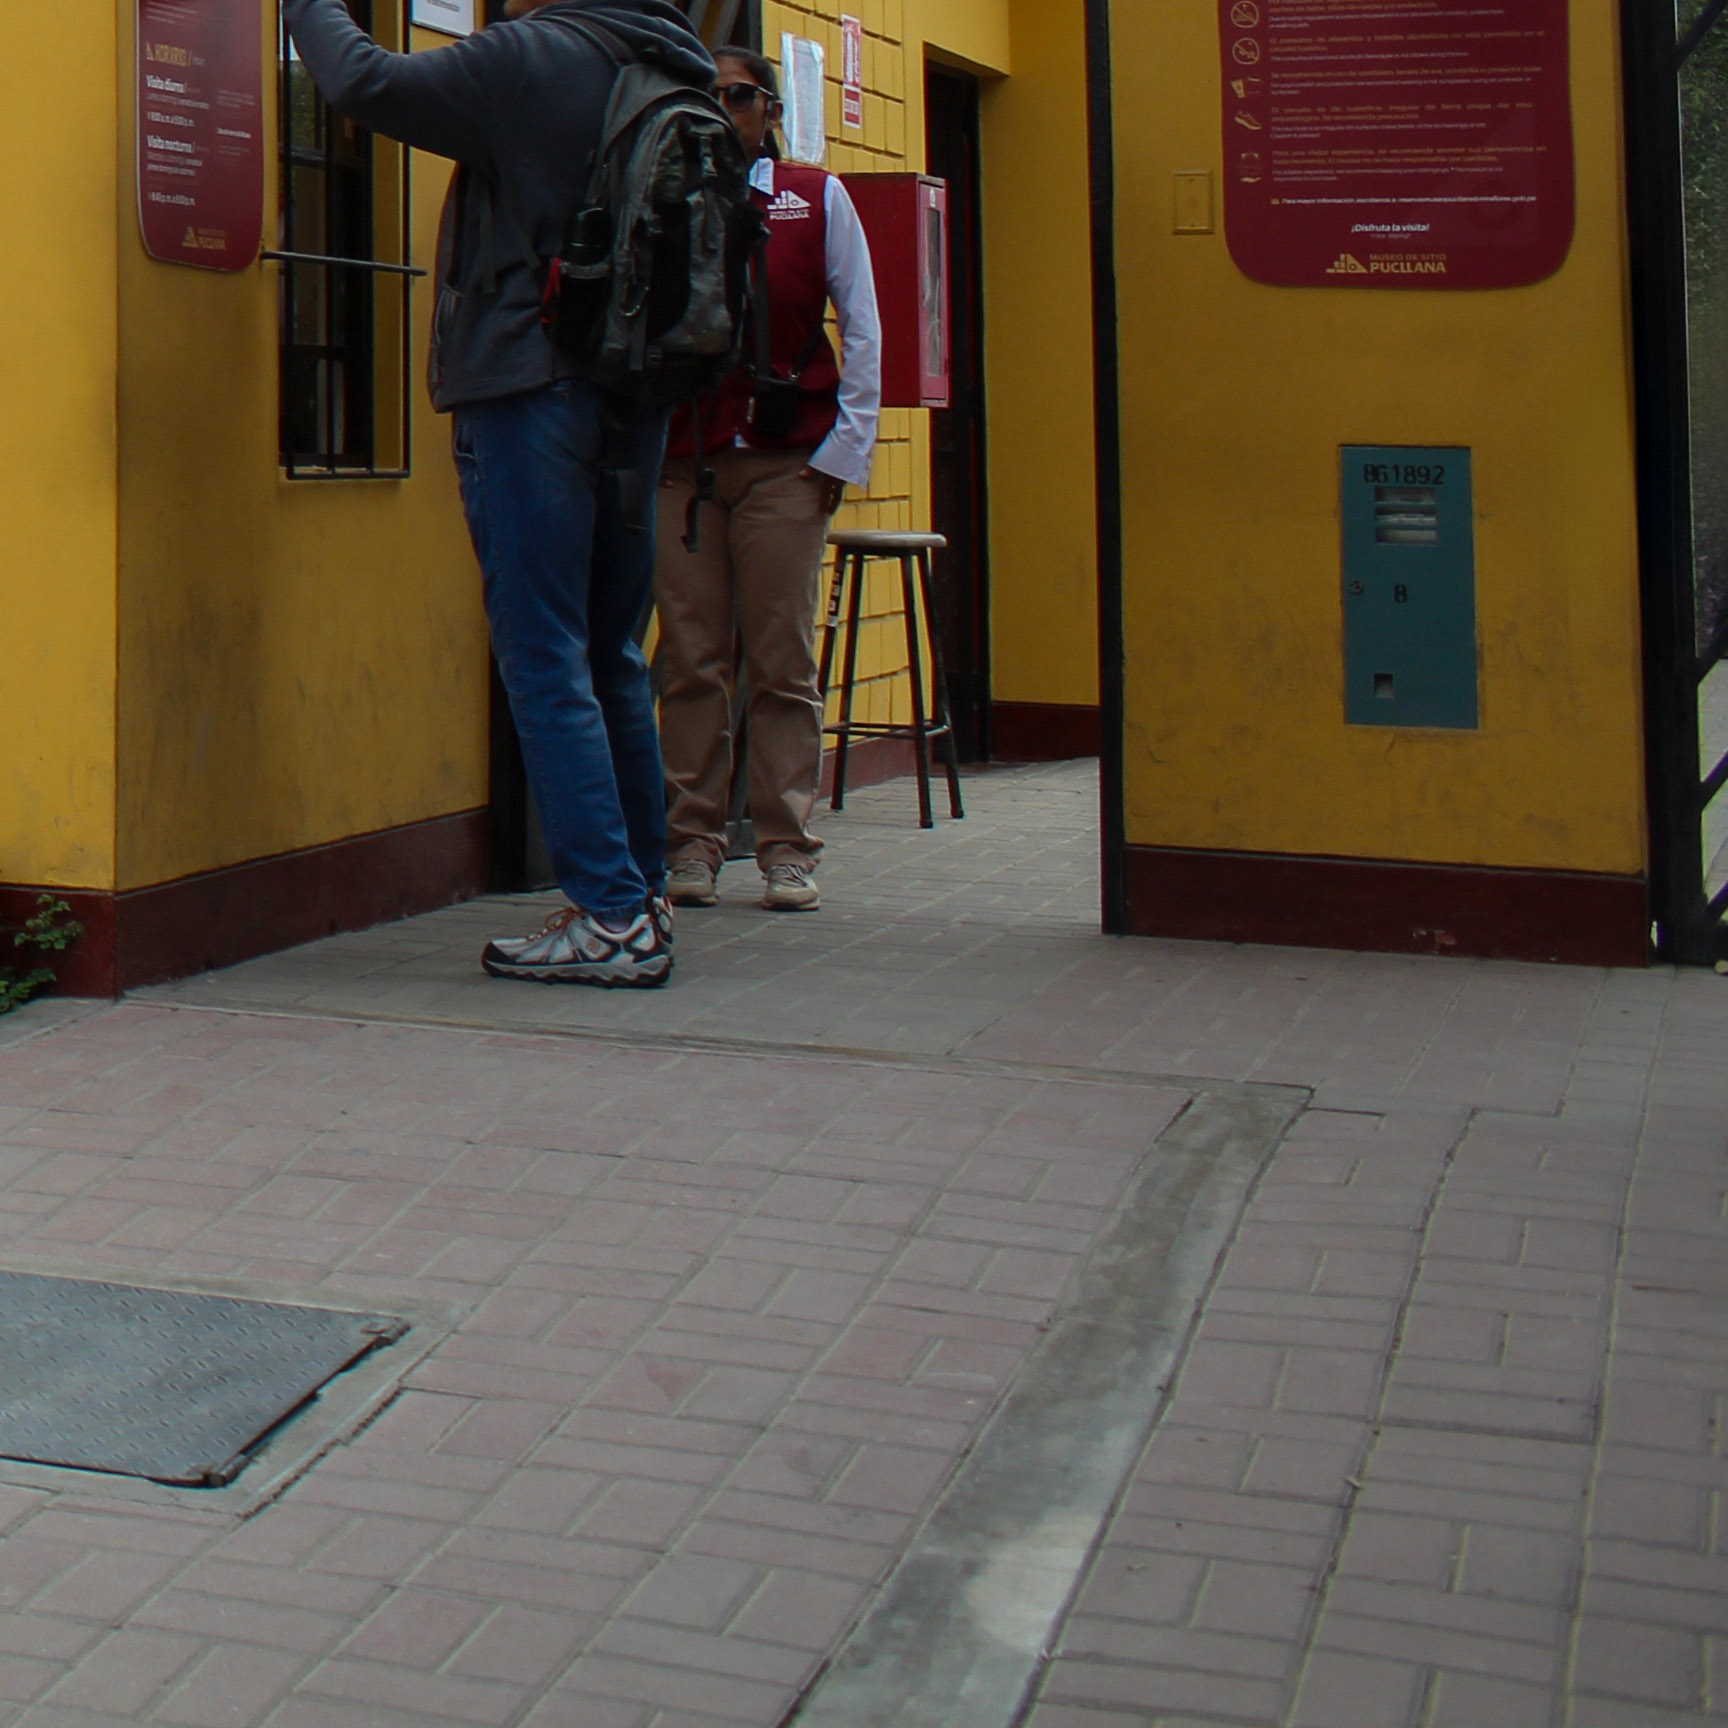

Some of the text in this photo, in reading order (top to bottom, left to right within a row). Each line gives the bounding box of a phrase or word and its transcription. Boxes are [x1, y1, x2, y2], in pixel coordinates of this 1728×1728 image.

[1351, 223, 1430, 233] ¡Disfruta la visita!
[1369, 253, 1447, 261] MUSEO DE SITIO
[1369, 261, 1447, 273] PUCLLANA
